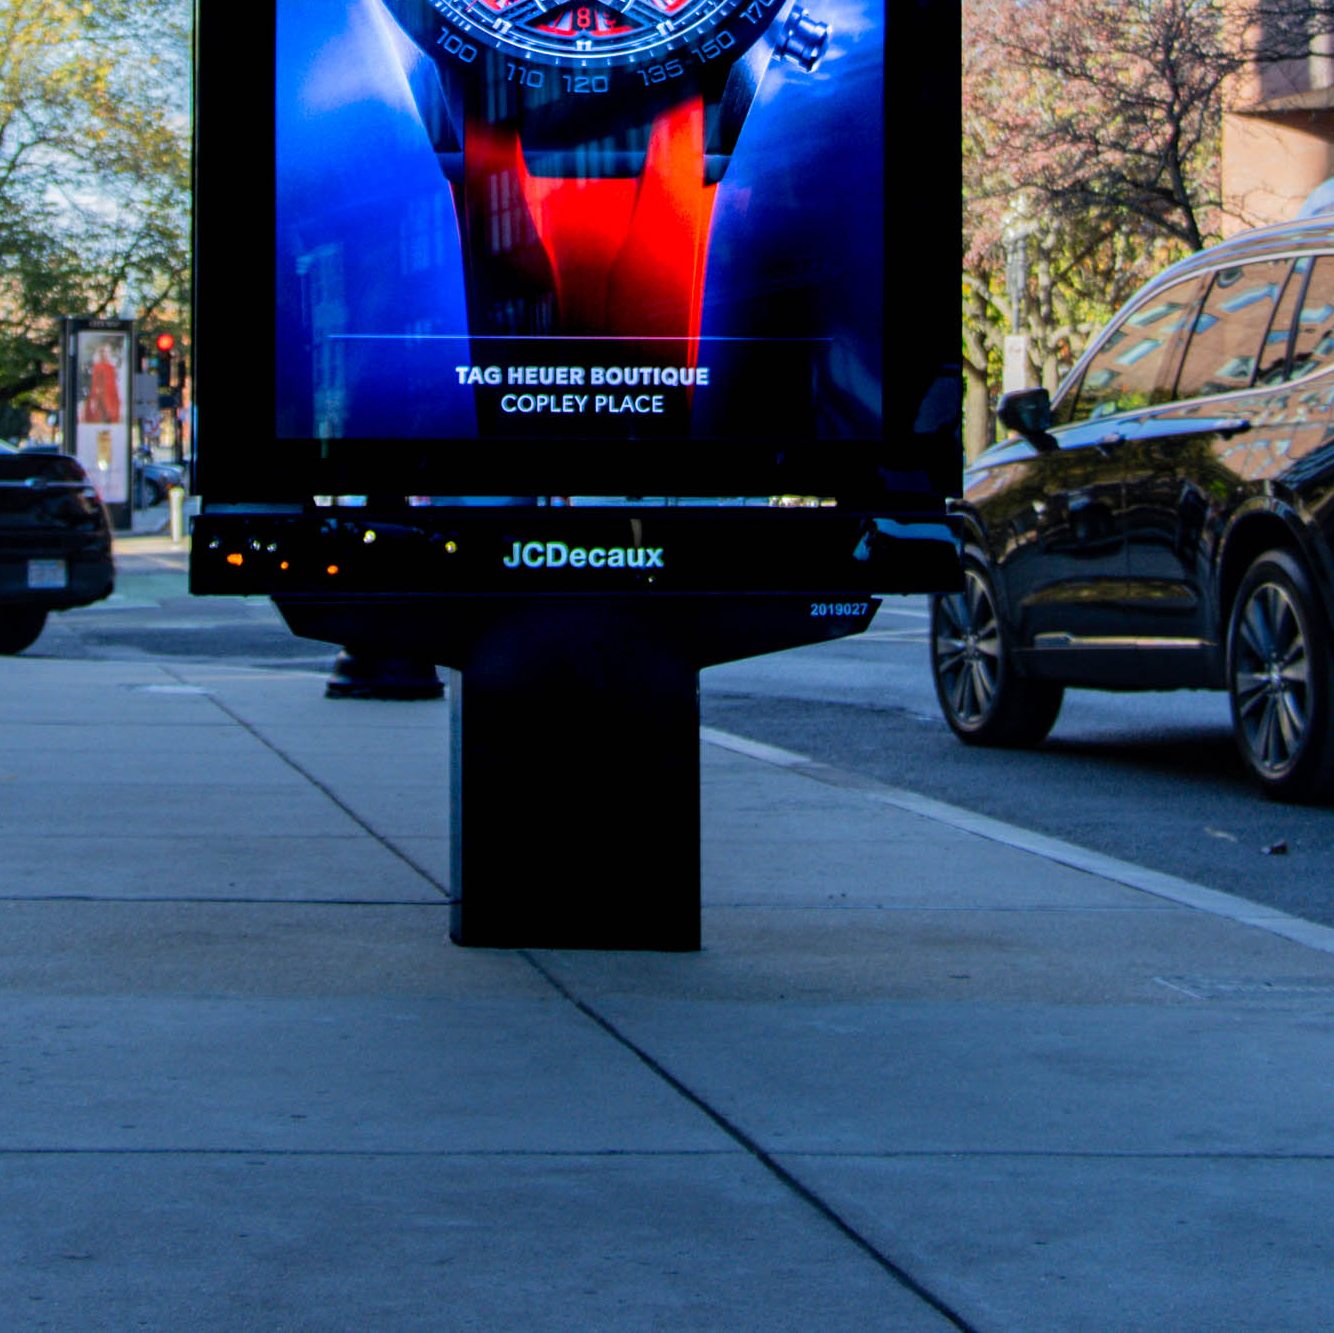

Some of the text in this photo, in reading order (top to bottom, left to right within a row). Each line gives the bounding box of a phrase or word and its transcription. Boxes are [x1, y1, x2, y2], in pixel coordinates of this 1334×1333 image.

[436, 26, 478, 63] 100
[692, 30, 735, 64] 150
[507, 62, 544, 88] 110
[563, 75, 609, 94] 120
[637, 58, 683, 86] 135
[455, 366, 709, 386] TAG HEUER BOUTIQUE
[500, 394, 665, 413] COPLEY PLACE
[502, 541, 665, 568] JCDecaux
[810, 602, 868, 617] 2019027
